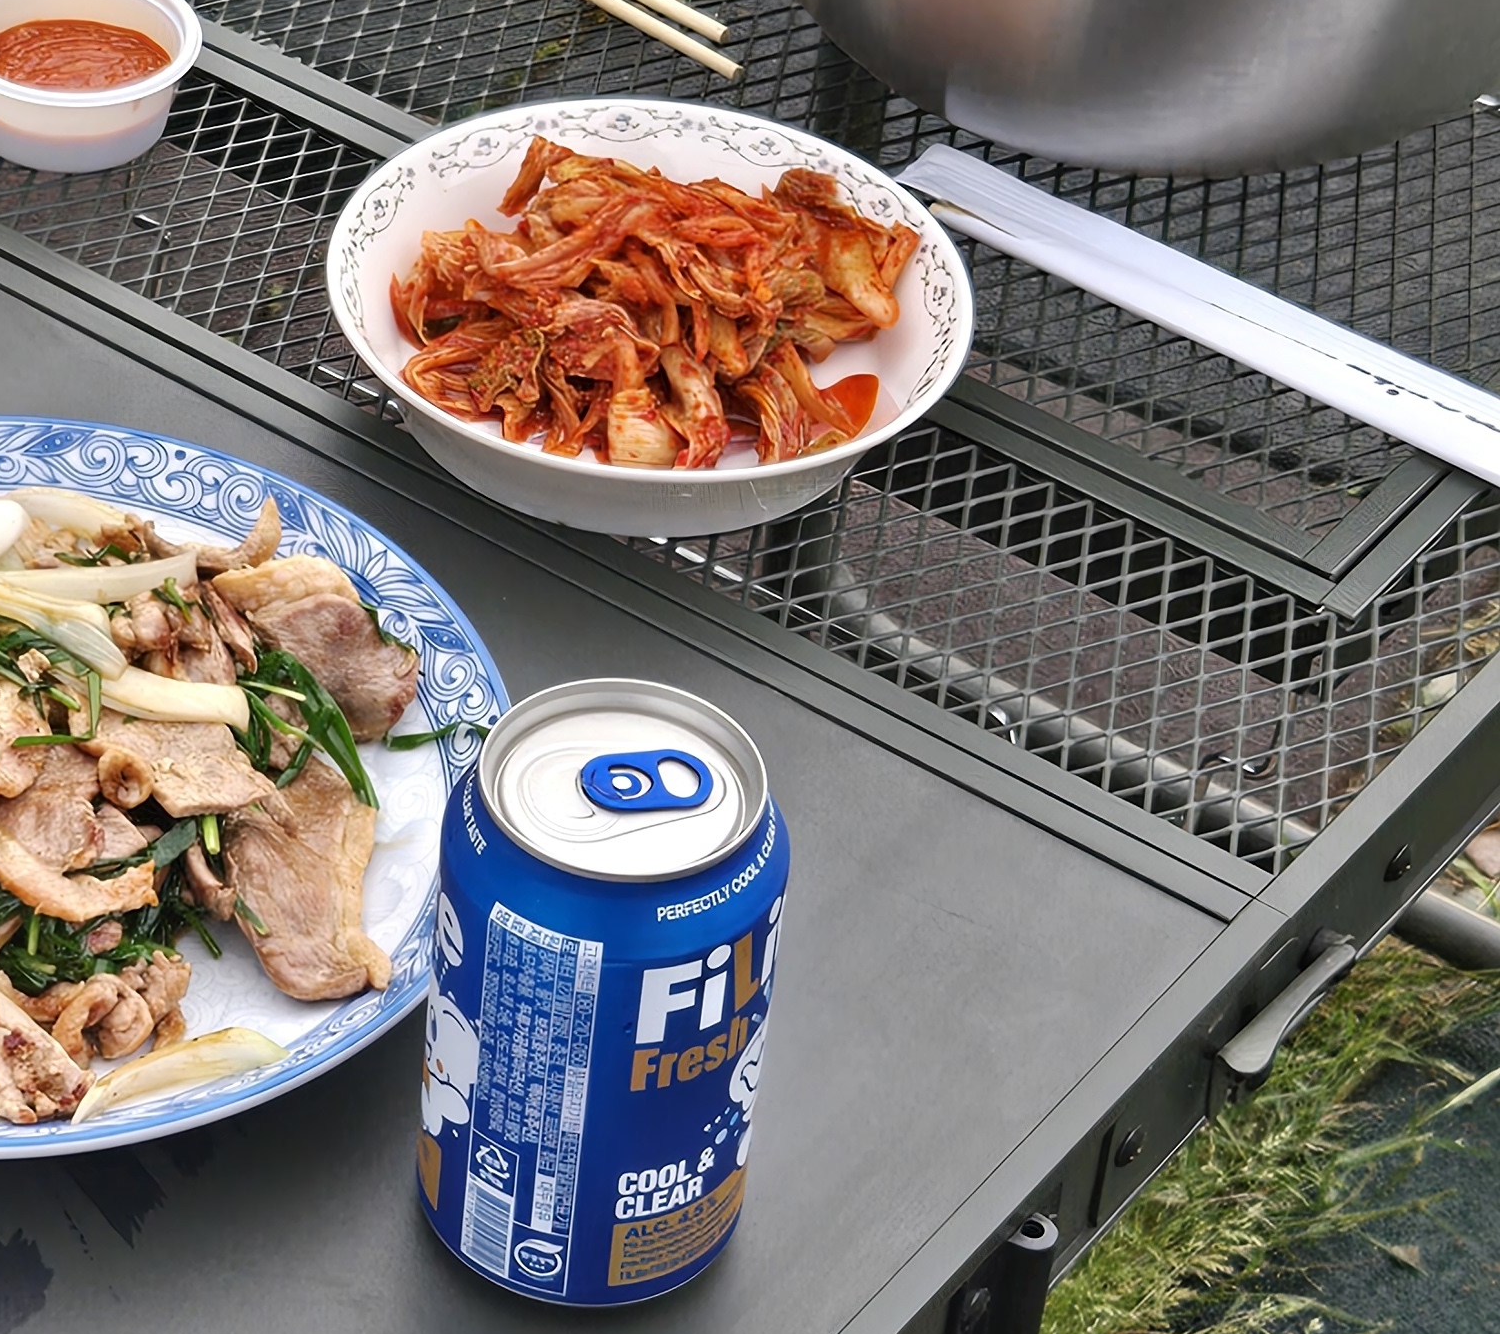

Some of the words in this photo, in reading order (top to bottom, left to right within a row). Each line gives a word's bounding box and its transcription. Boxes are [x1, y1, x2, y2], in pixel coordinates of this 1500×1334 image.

[466, 815, 488, 855] TASTE
[657, 884, 730, 922] PERFECTLY
[731, 865, 760, 893] COOL
[634, 894, 786, 1044] FiLi
[630, 1015, 749, 1092] Fresh
[615, 1175, 703, 1219] CLEAR
[618, 1159, 692, 1196] COOL
[697, 1147, 715, 1173] &
